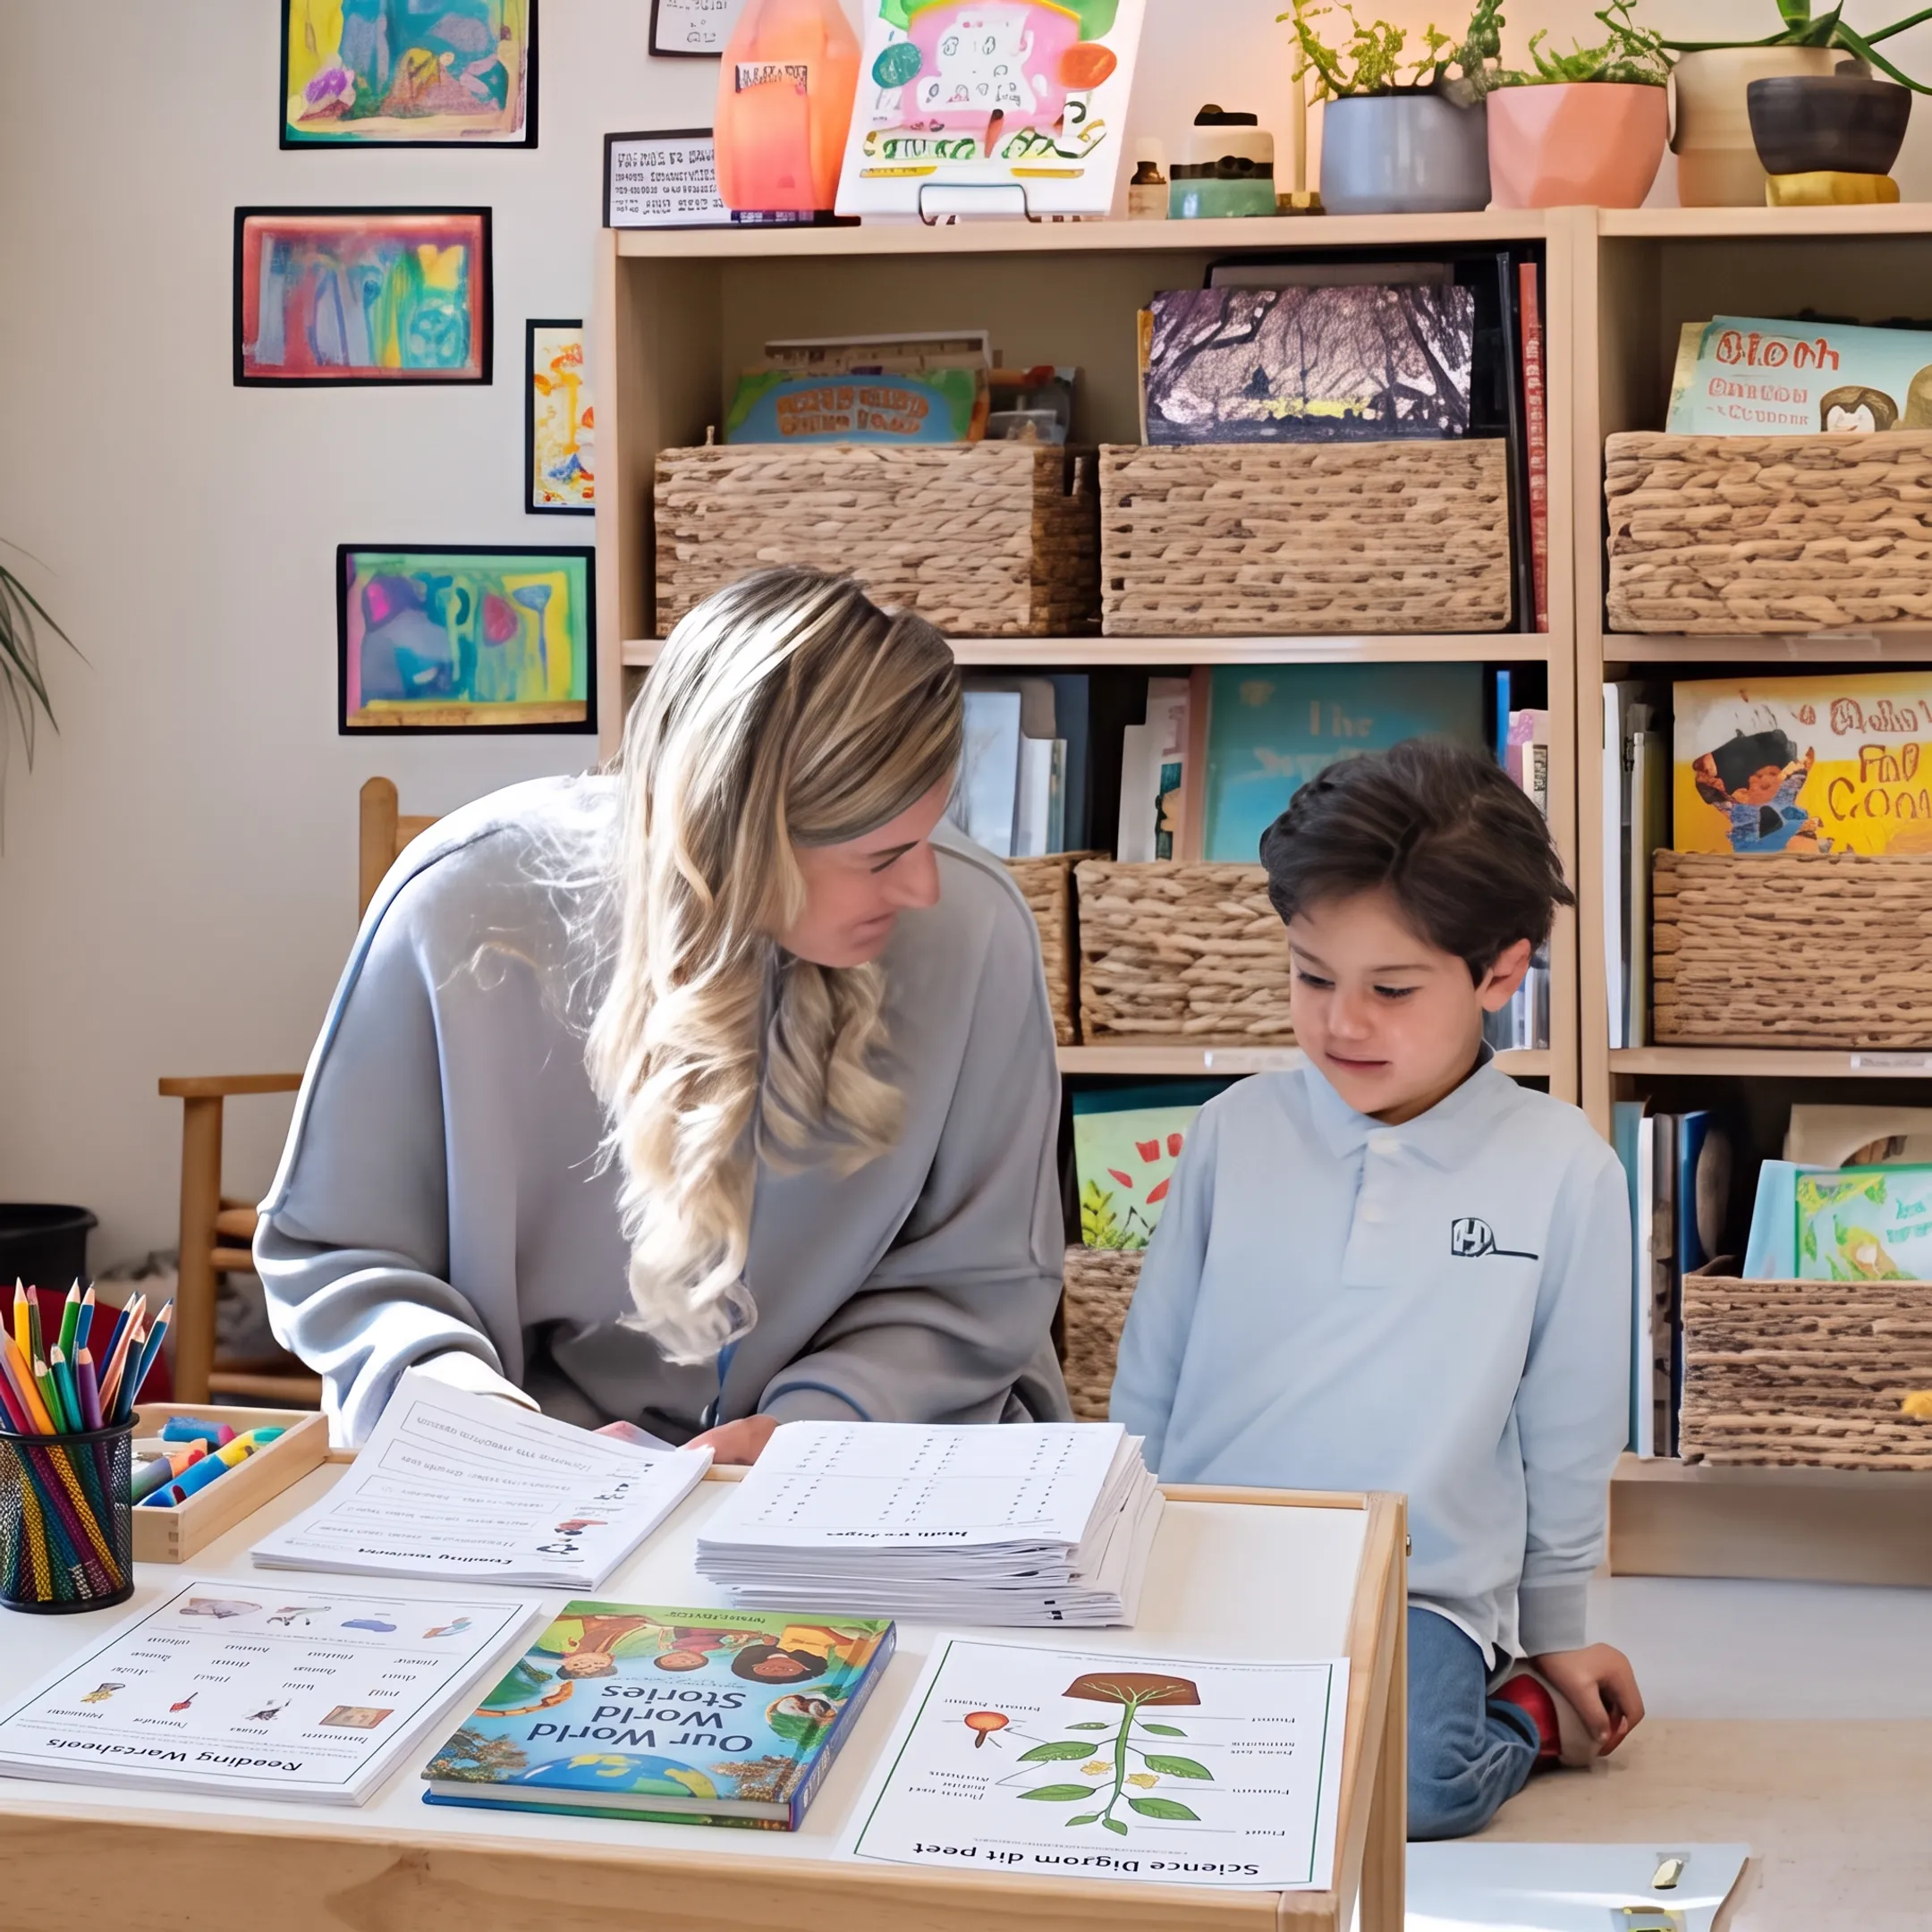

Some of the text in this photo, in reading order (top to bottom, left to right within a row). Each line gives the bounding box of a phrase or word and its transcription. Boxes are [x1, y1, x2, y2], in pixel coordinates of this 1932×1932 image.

[601, 1685, 746, 1709] Stories
[591, 1706, 723, 1729] World
[527, 1723, 752, 1752] Our World
[912, 1843, 977, 1857] peet
[986, 1851, 1023, 1865] dit
[1149, 1861, 1258, 1876] Science
